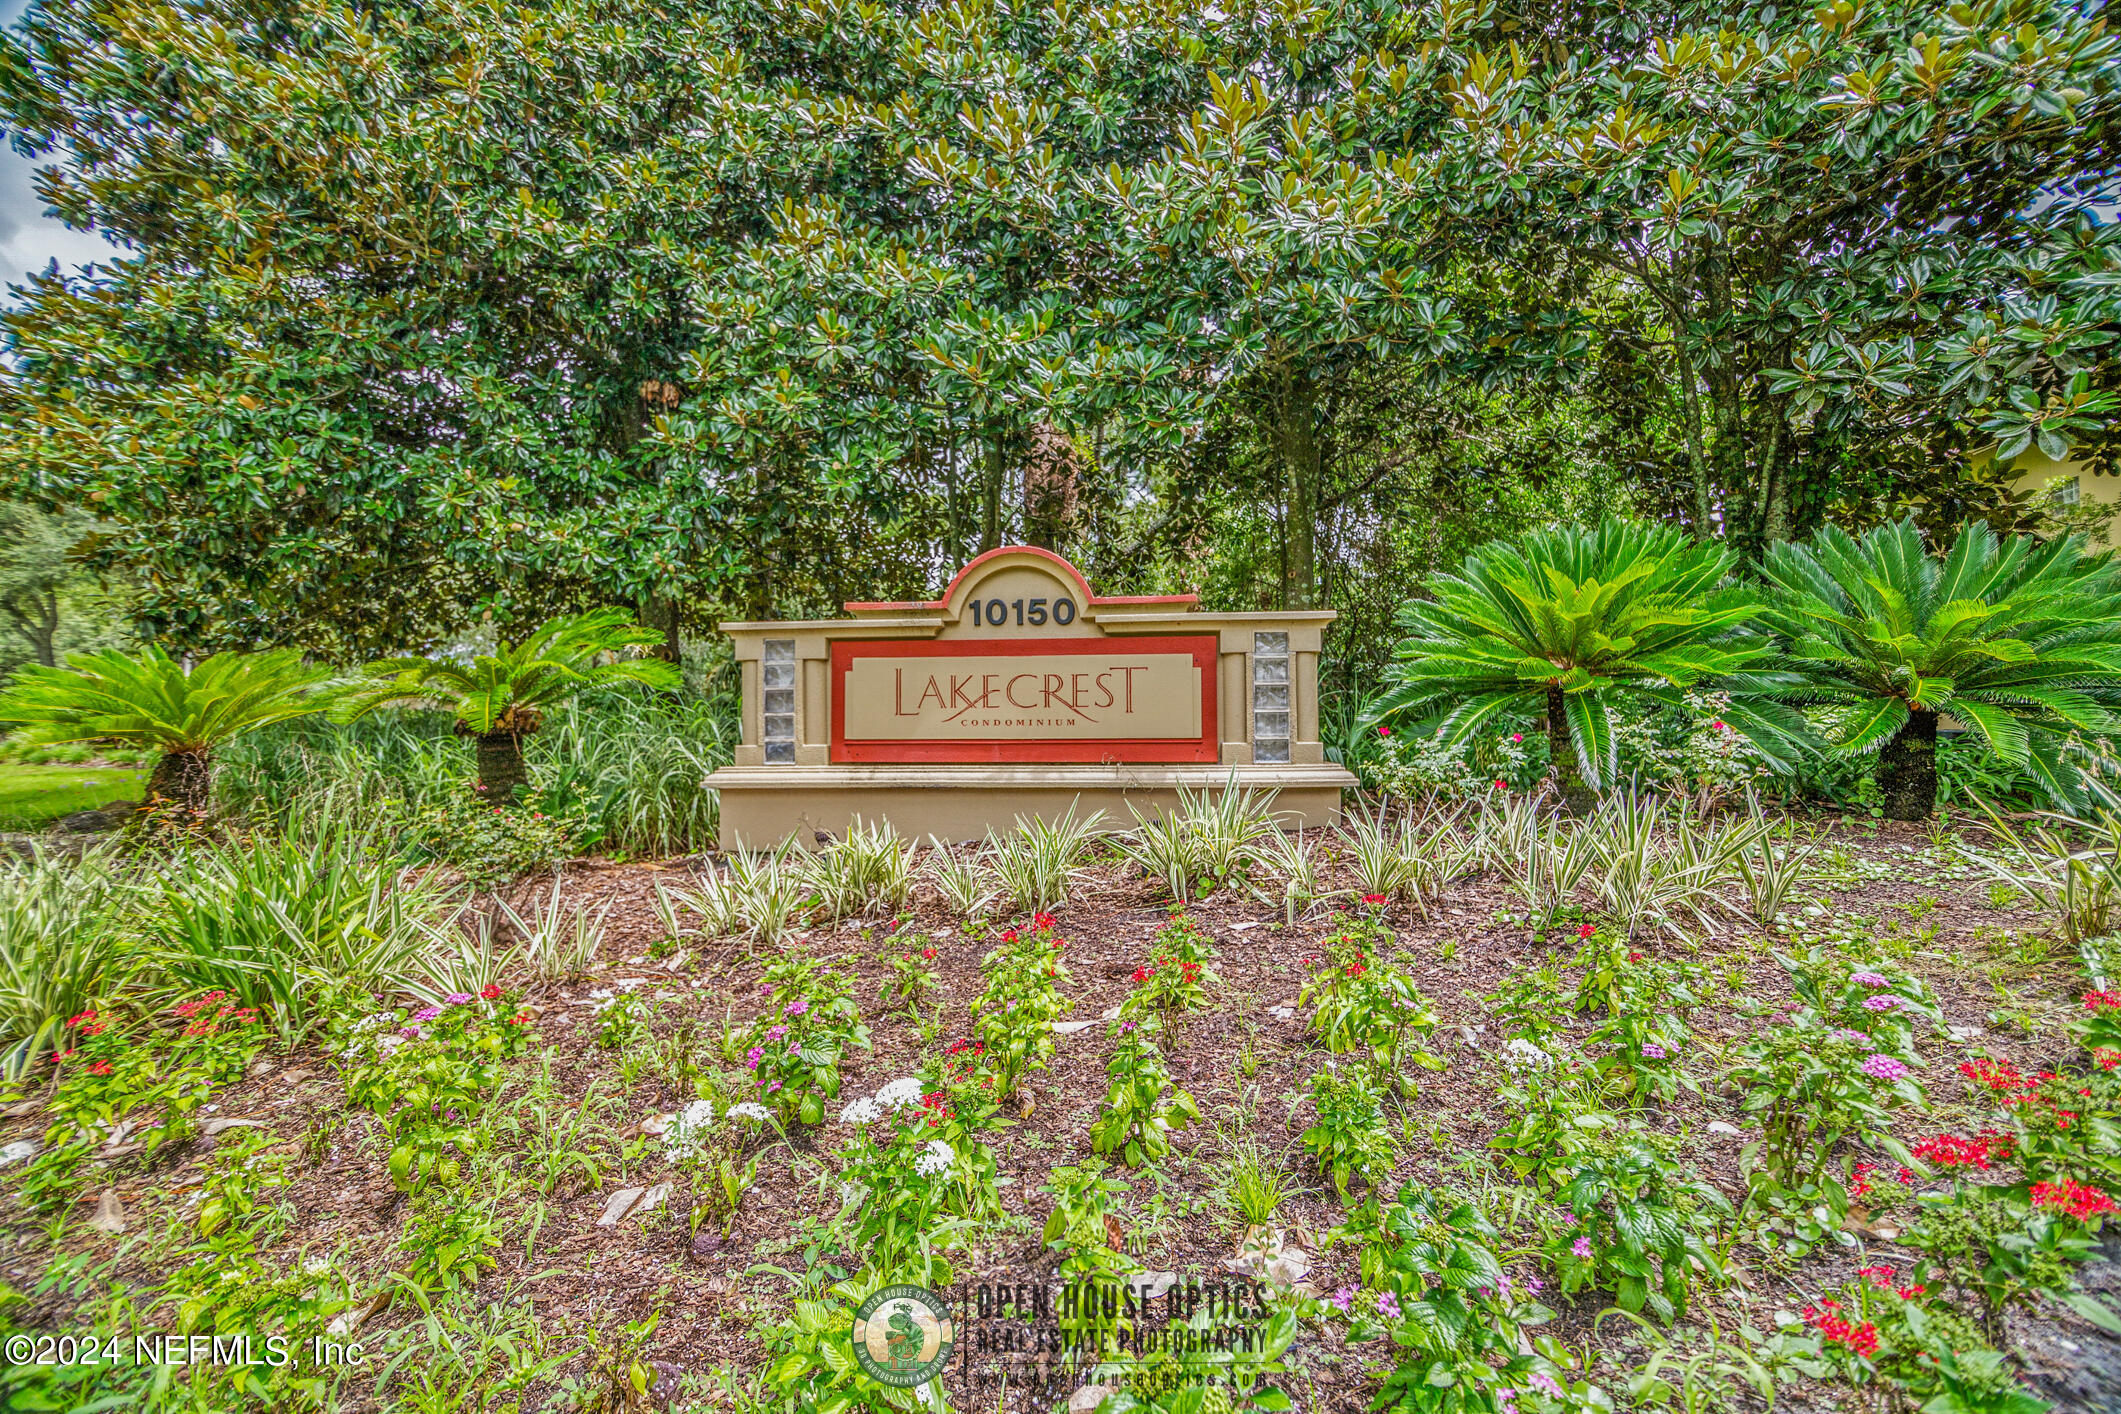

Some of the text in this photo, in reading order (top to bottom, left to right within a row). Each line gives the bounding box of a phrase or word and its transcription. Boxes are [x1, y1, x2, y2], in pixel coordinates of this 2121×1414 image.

[968, 597, 1076, 626] 10150
[894, 666, 1149, 723] LAKECREST
[960, 718, 1076, 727] CONDOMINIUM
